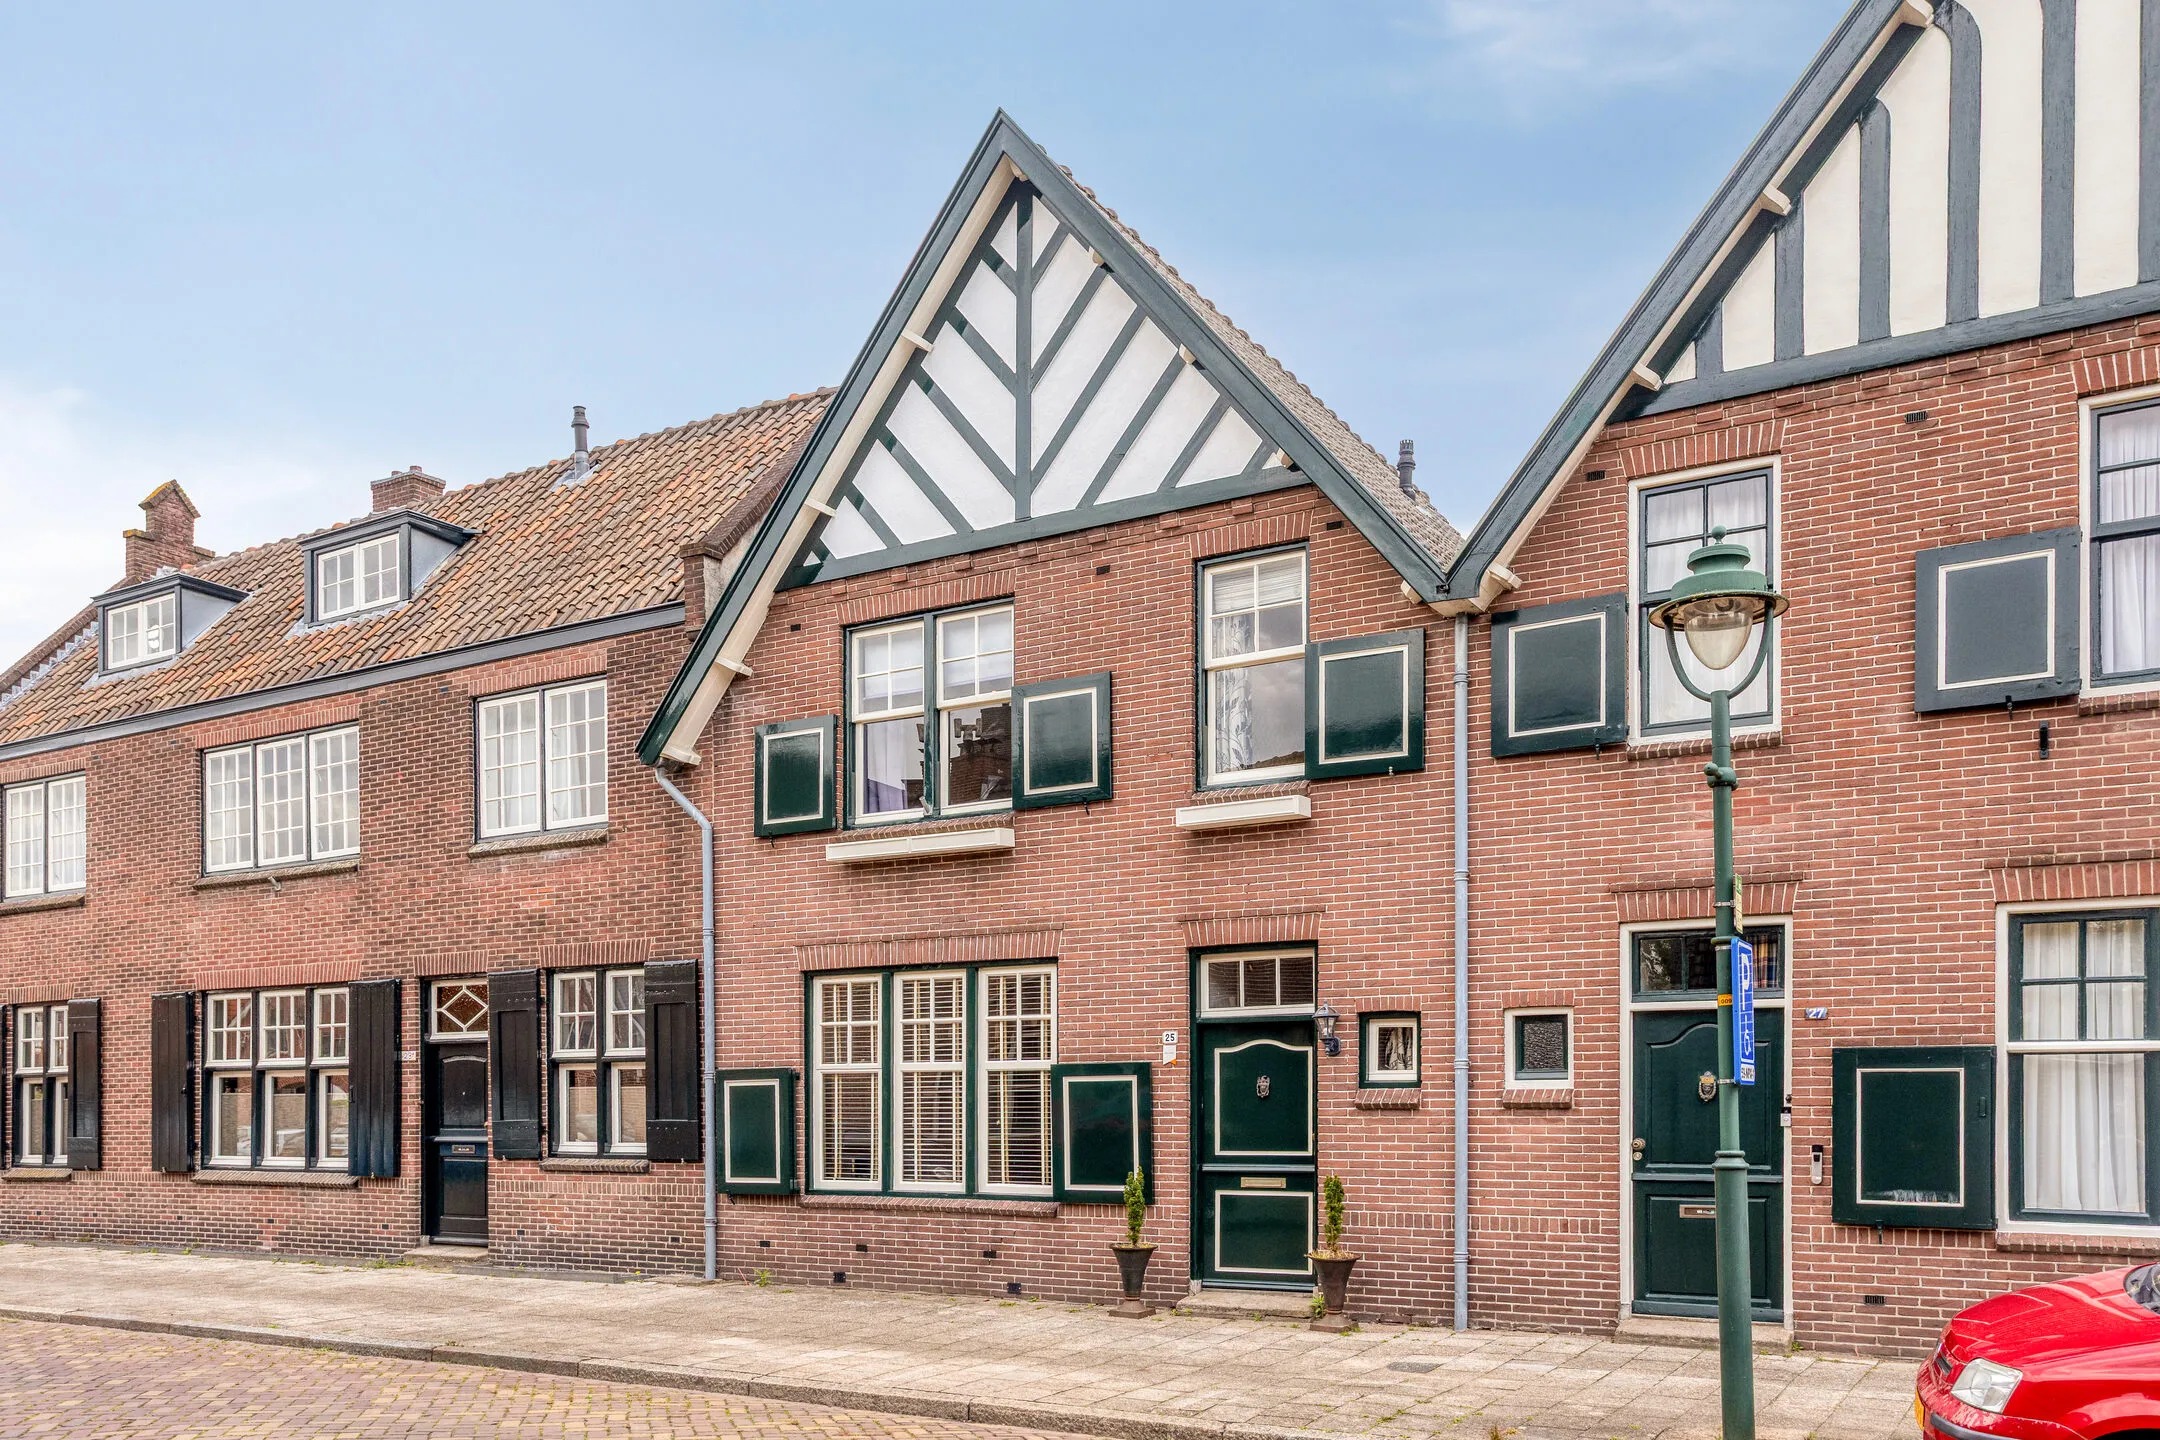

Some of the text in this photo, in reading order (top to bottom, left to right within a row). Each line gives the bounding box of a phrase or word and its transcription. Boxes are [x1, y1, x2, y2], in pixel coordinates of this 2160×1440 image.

[1741, 952, 1750, 1011] P
[1808, 1008, 1824, 1018] 27
[1165, 1033, 1175, 1041] 25
